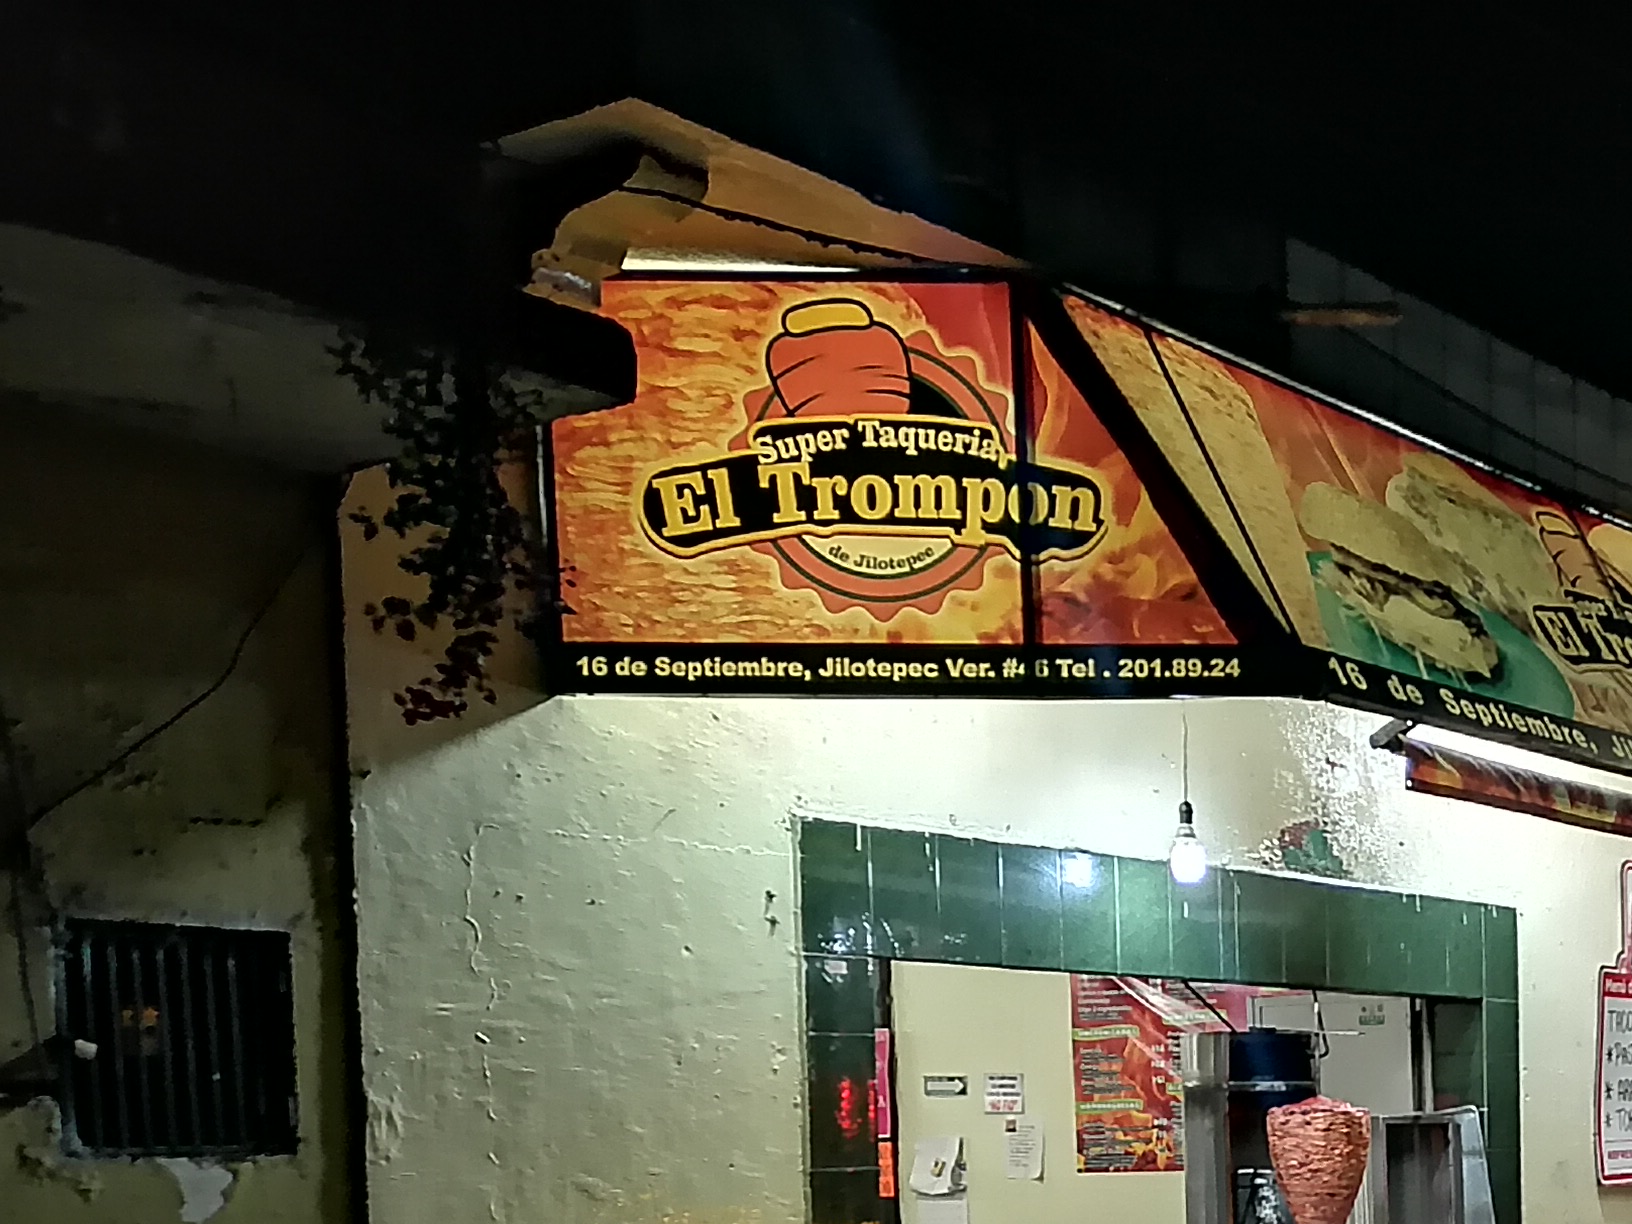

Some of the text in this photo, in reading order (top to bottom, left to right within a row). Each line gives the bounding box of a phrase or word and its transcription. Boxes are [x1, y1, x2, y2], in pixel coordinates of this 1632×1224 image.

[755, 431, 850, 464] Super
[652, 462, 1098, 541] El Trompon
[828, 545, 935, 572] de Jilotepec
[1536, 611, 1590, 657] El
[576, 656, 608, 679] 16
[615, 656, 647, 678] de
[654, 656, 812, 682] Septiembre,
[819, 656, 938, 682] Jilotepec
[945, 656, 996, 678] Ver.
[1055, 657, 1096, 678] Tel
[1118, 656, 1240, 679] 201.89.24
[1328, 656, 1367, 690] 16
[1387, 674, 1424, 706] de
[1439, 687, 1598, 755] Septiembre,
